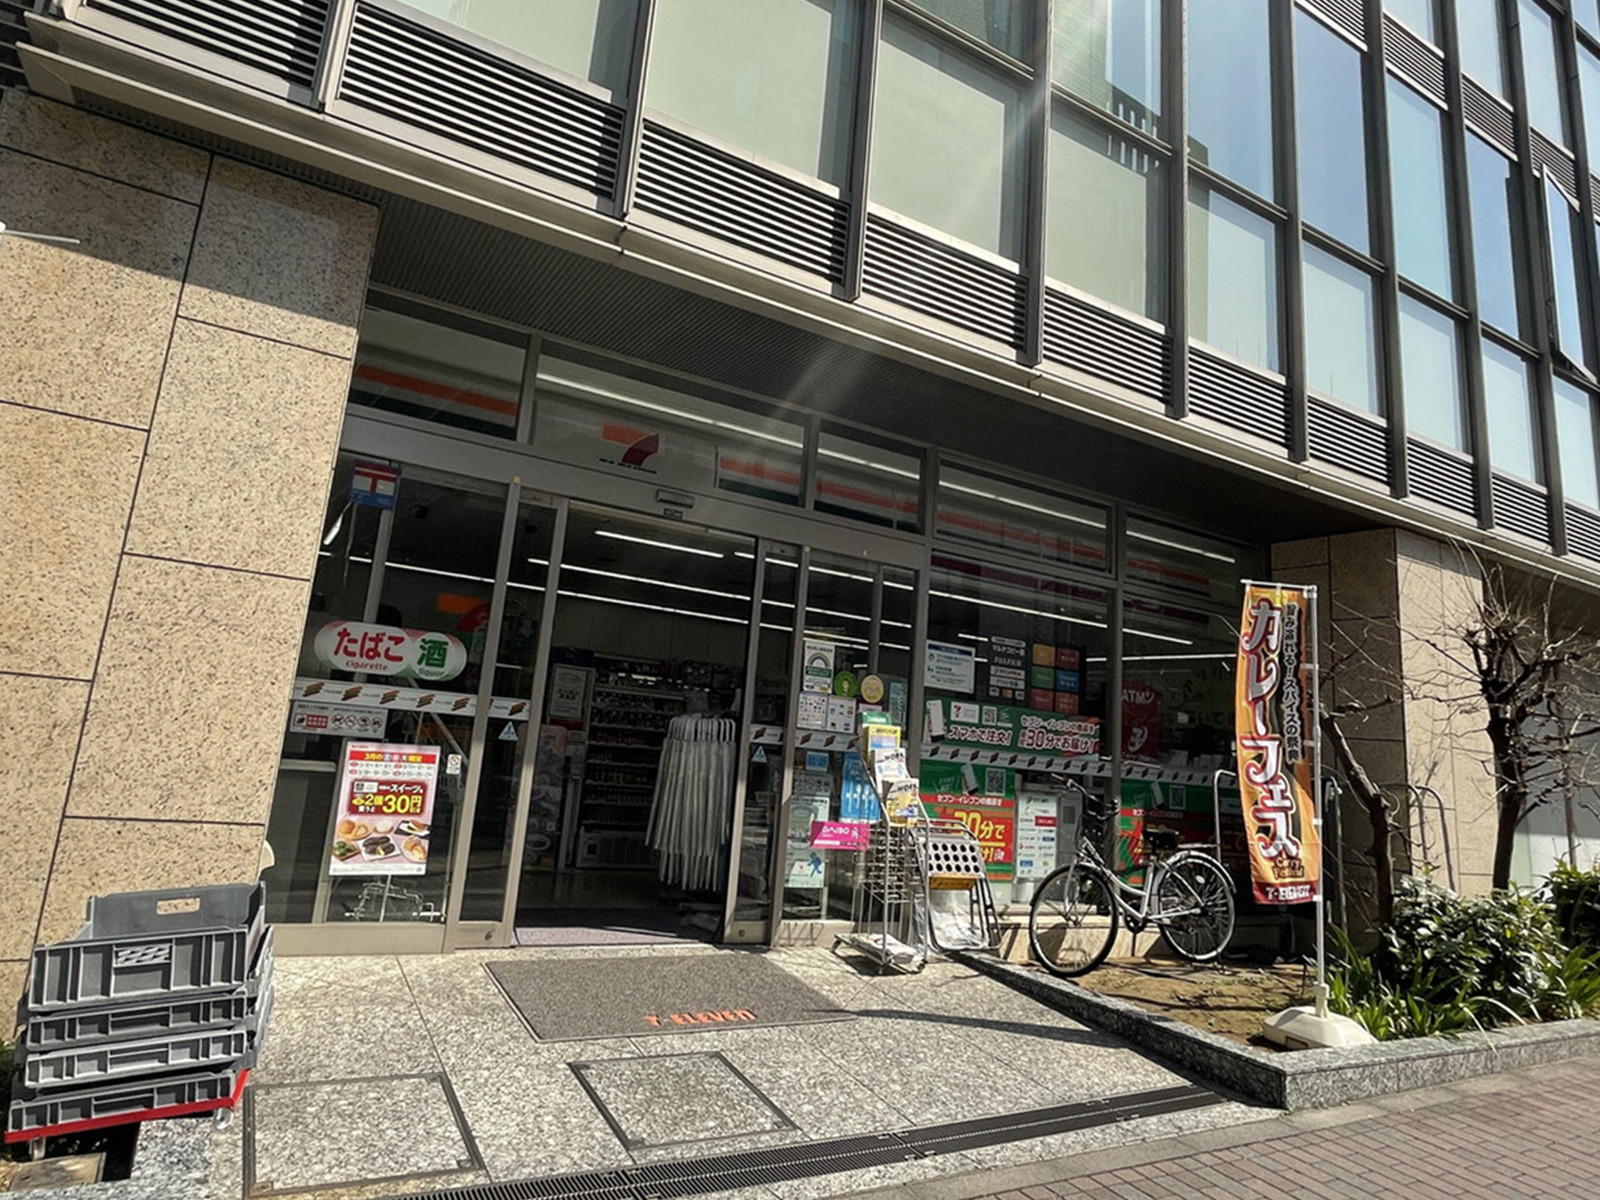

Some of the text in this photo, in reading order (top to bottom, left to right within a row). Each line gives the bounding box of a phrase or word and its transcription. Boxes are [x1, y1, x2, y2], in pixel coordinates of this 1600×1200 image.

[334, 628, 405, 663] たばこ
[416, 638, 449, 668] 酒
[345, 660, 389, 671] cigarette
[1240, 599, 1300, 858] カレーフェス
